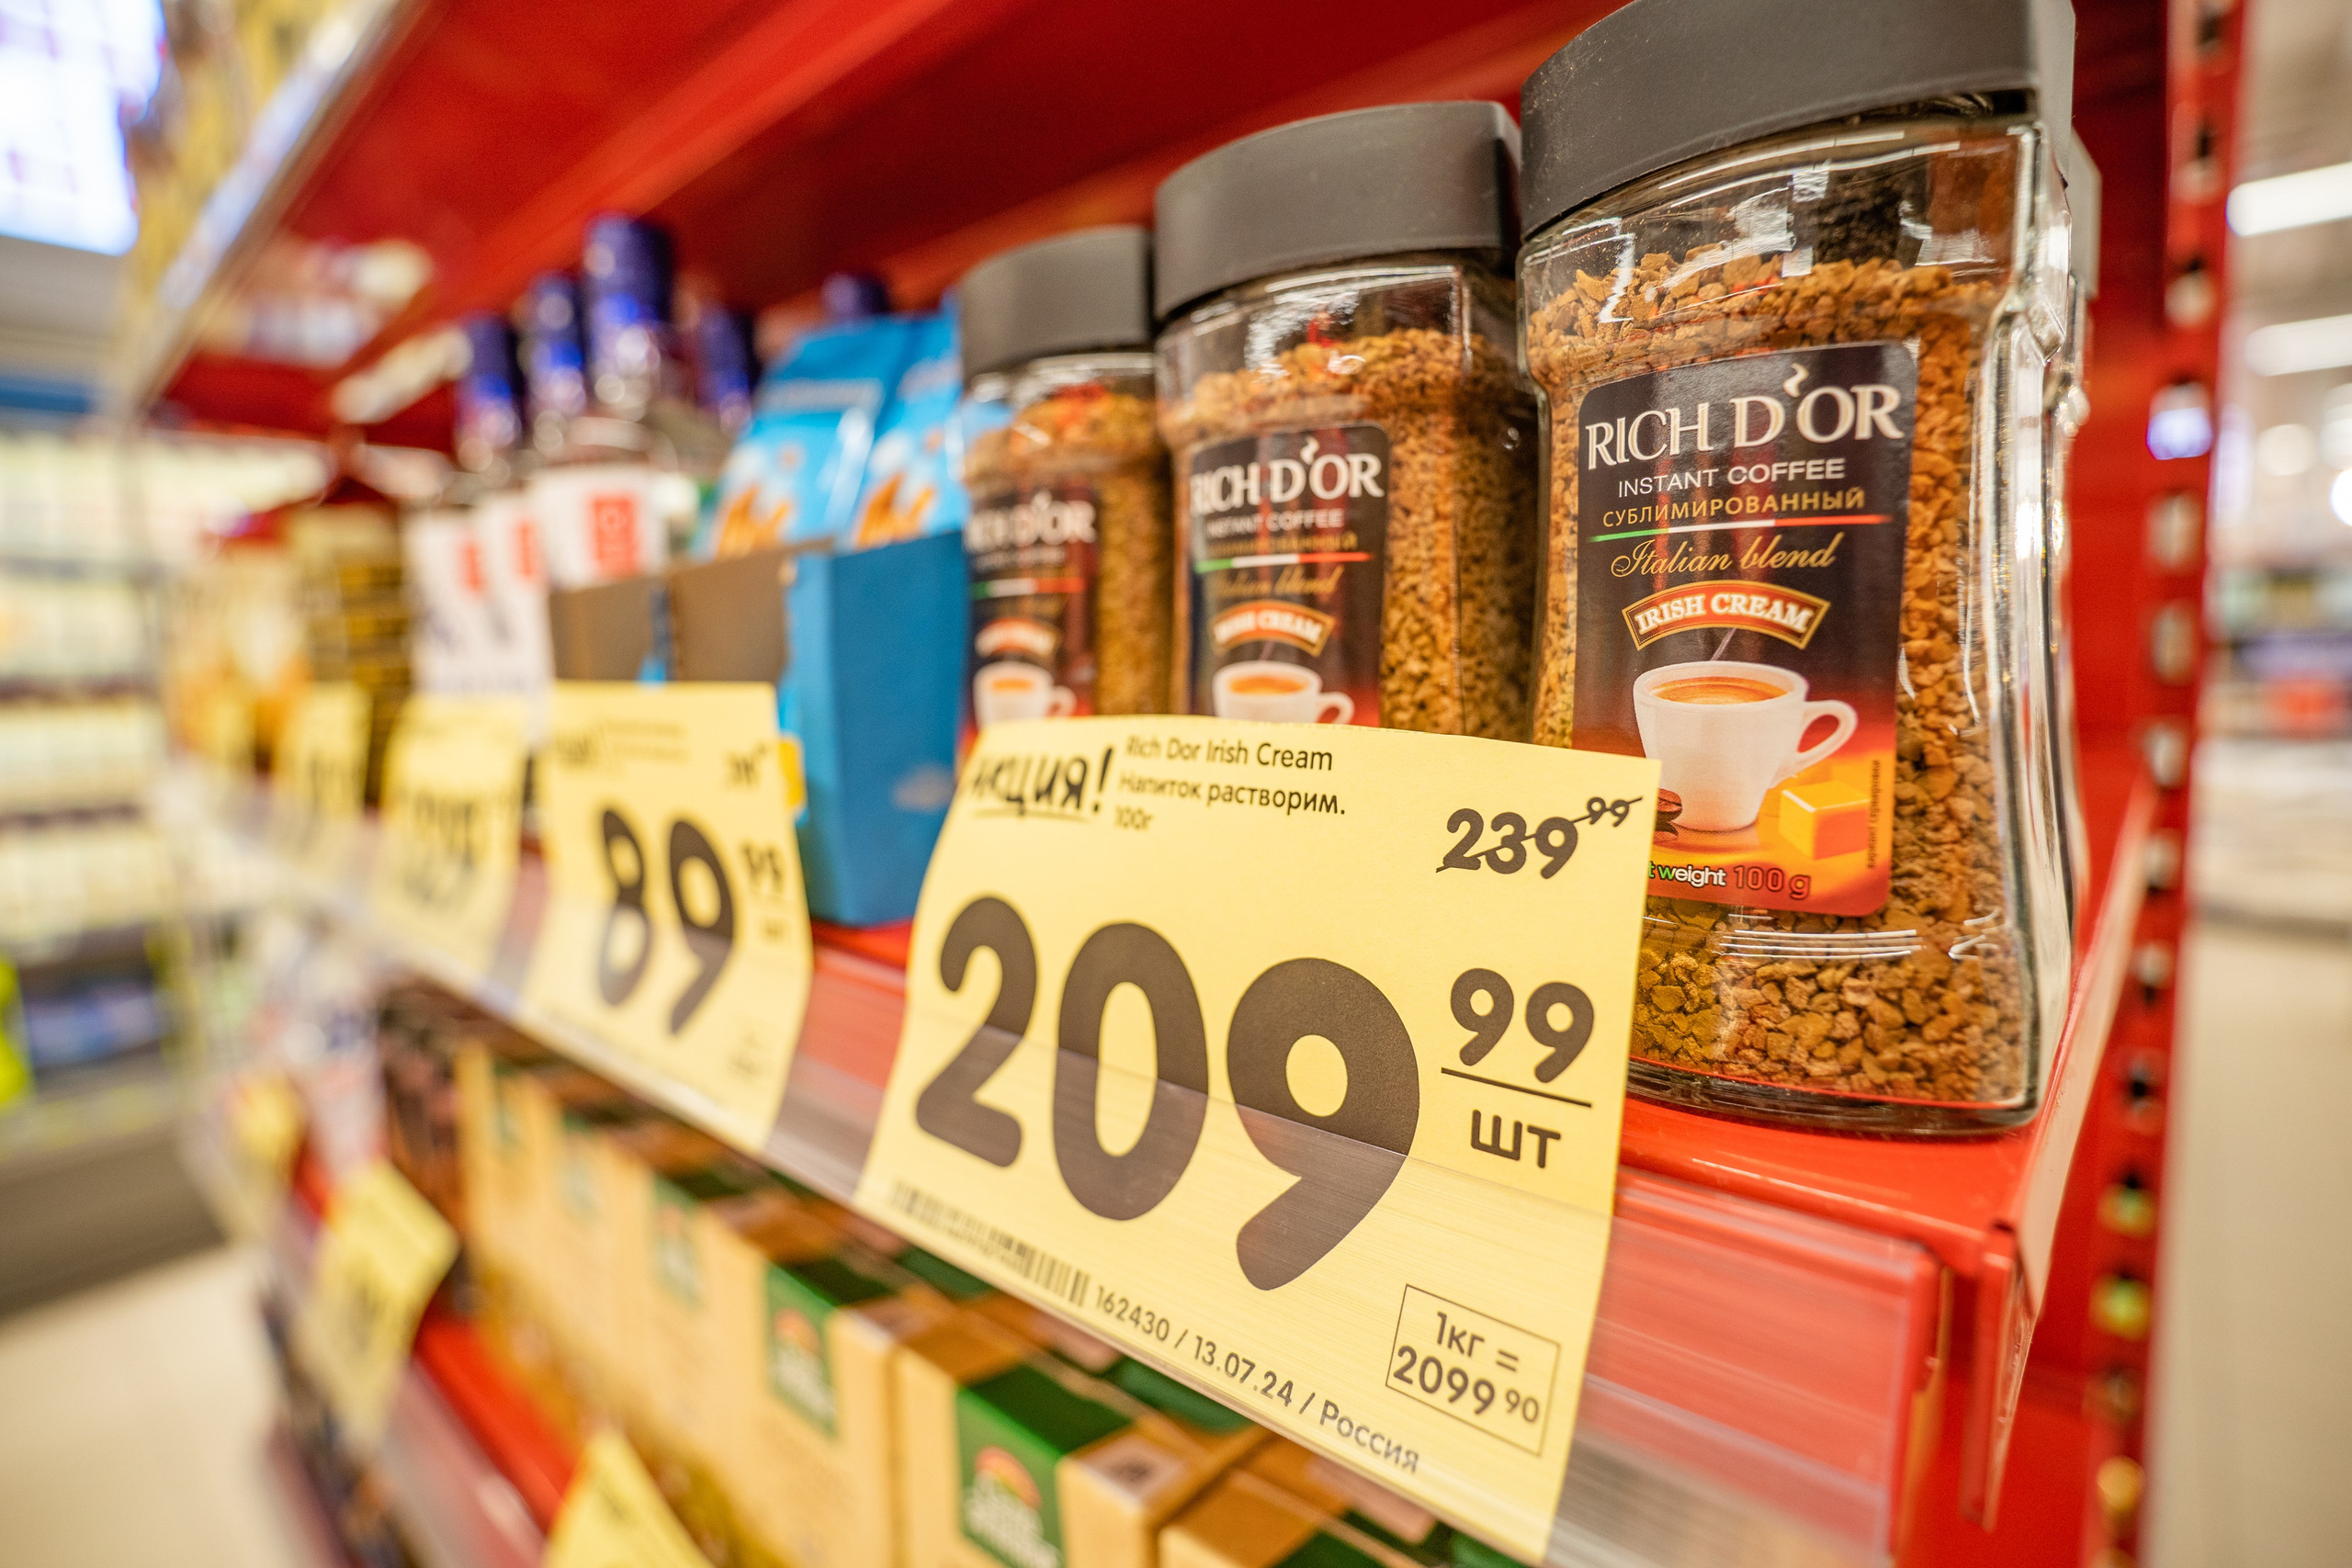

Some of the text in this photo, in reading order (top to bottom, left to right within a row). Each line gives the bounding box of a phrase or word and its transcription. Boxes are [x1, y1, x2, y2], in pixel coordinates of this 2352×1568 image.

[1585, 402, 1714, 470] RICH
[1619, 457, 1847, 498] INSTANT COFFEE
[1602, 487, 1865, 528] СУБЛИМИРОВАННЫЙ
[1611, 532, 1845, 579] Italian blend
[1634, 592, 1814, 635] IRISH CREAM
[1167, 738, 1200, 761] Dor
[1206, 739, 1248, 764] Irish
[1257, 742, 1333, 772] Cream
[1118, 772, 1347, 816] Напиток растворим.
[1442, 807, 1578, 879] 239
[1657, 863, 1727, 888] weight
[1733, 865, 1784, 892] 100
[1790, 874, 1812, 899] g
[597, 807, 735, 1038] 89
[916, 897, 1594, 1291] 209 99
[1095, 1285, 1170, 1342] 162430
[1193, 1335, 1294, 1408] 13.07.24
[1319, 1399, 1419, 1473] Россия
[1393, 1345, 1540, 1424] 2099 90
